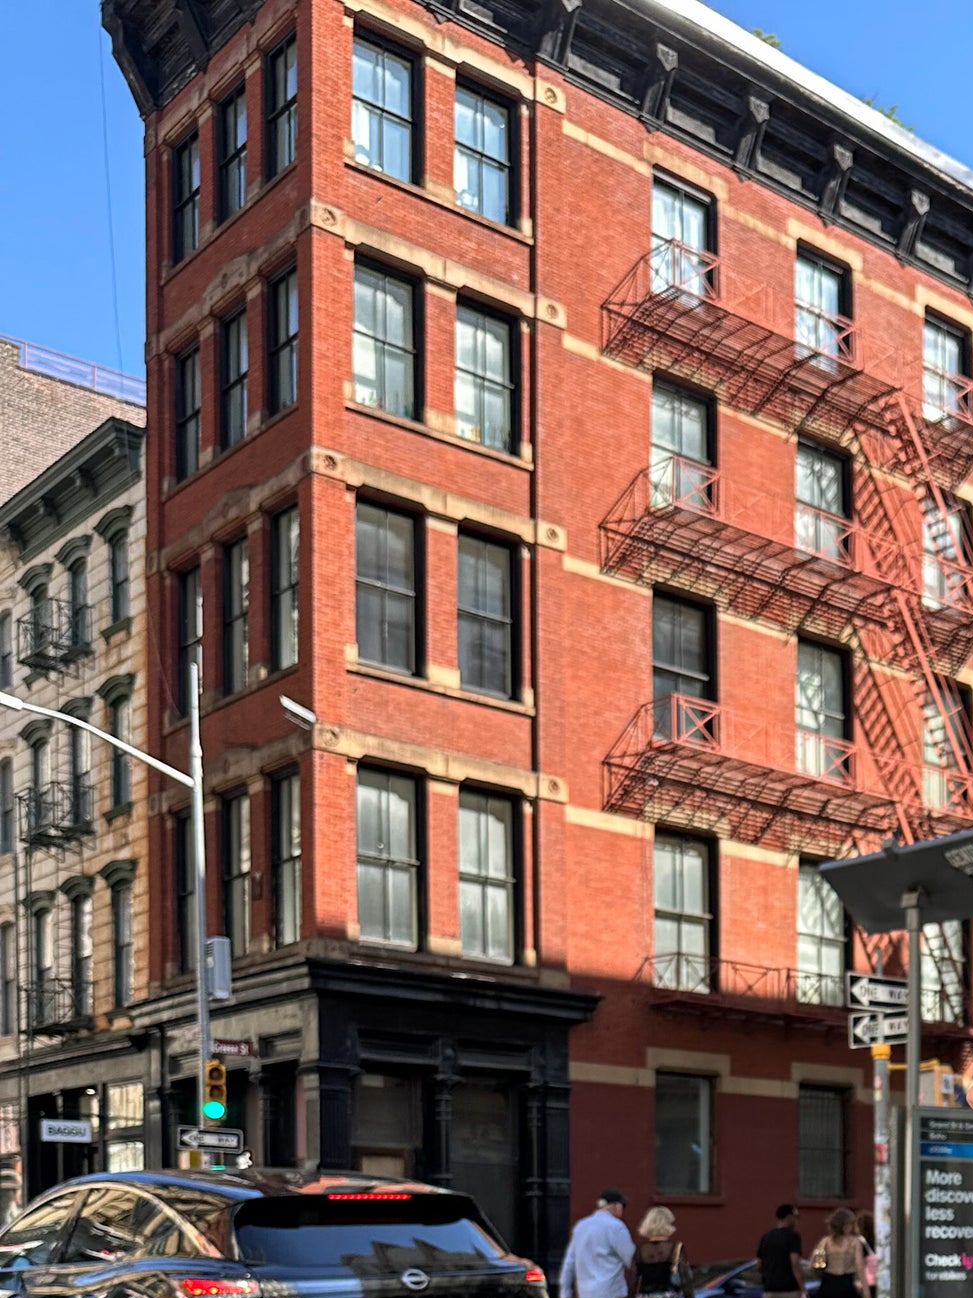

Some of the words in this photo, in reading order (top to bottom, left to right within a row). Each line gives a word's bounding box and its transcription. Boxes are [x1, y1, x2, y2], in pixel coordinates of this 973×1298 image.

[860, 985, 877, 997] ONE
[862, 1021, 879, 1036] ONE
[926, 1169, 962, 1186] More
[925, 1206, 955, 1221] less
[925, 1253, 961, 1267] Check
